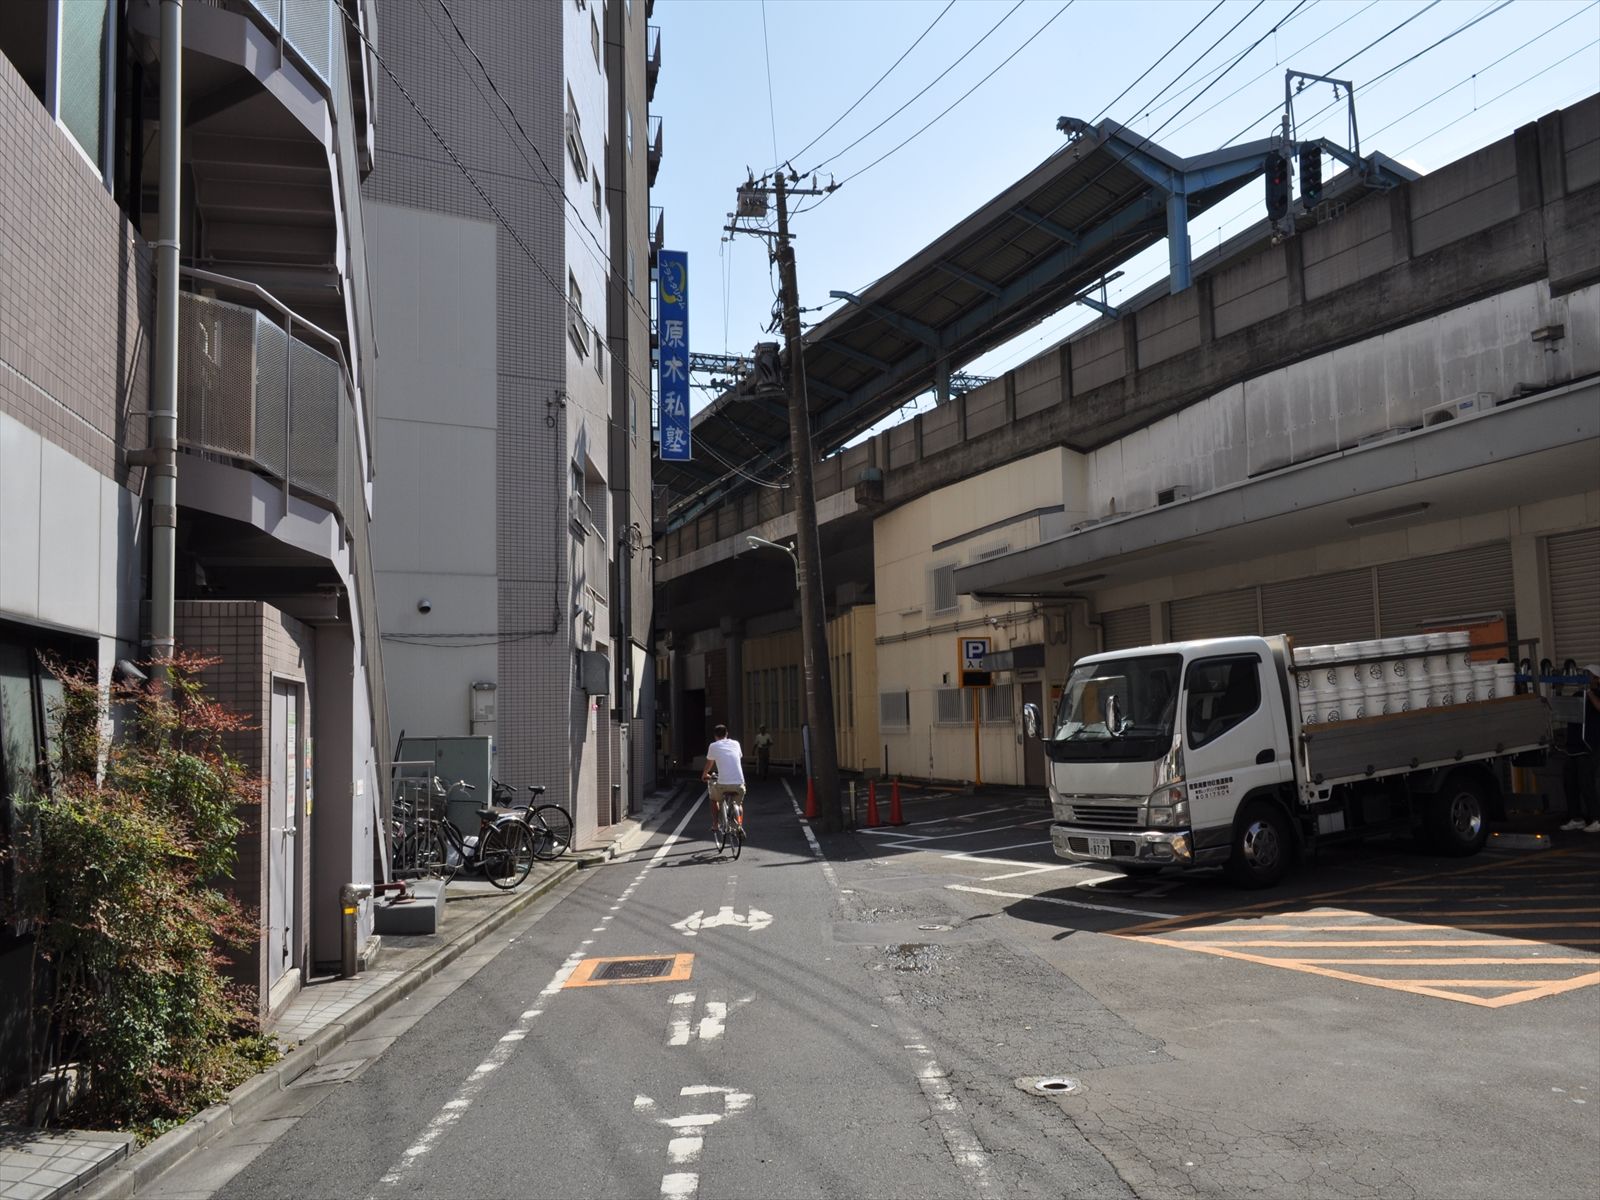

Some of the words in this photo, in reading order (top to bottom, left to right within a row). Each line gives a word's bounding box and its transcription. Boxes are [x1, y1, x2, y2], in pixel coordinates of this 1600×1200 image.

[662, 319, 687, 453] 原木私塾
[968, 643, 984, 658] P
